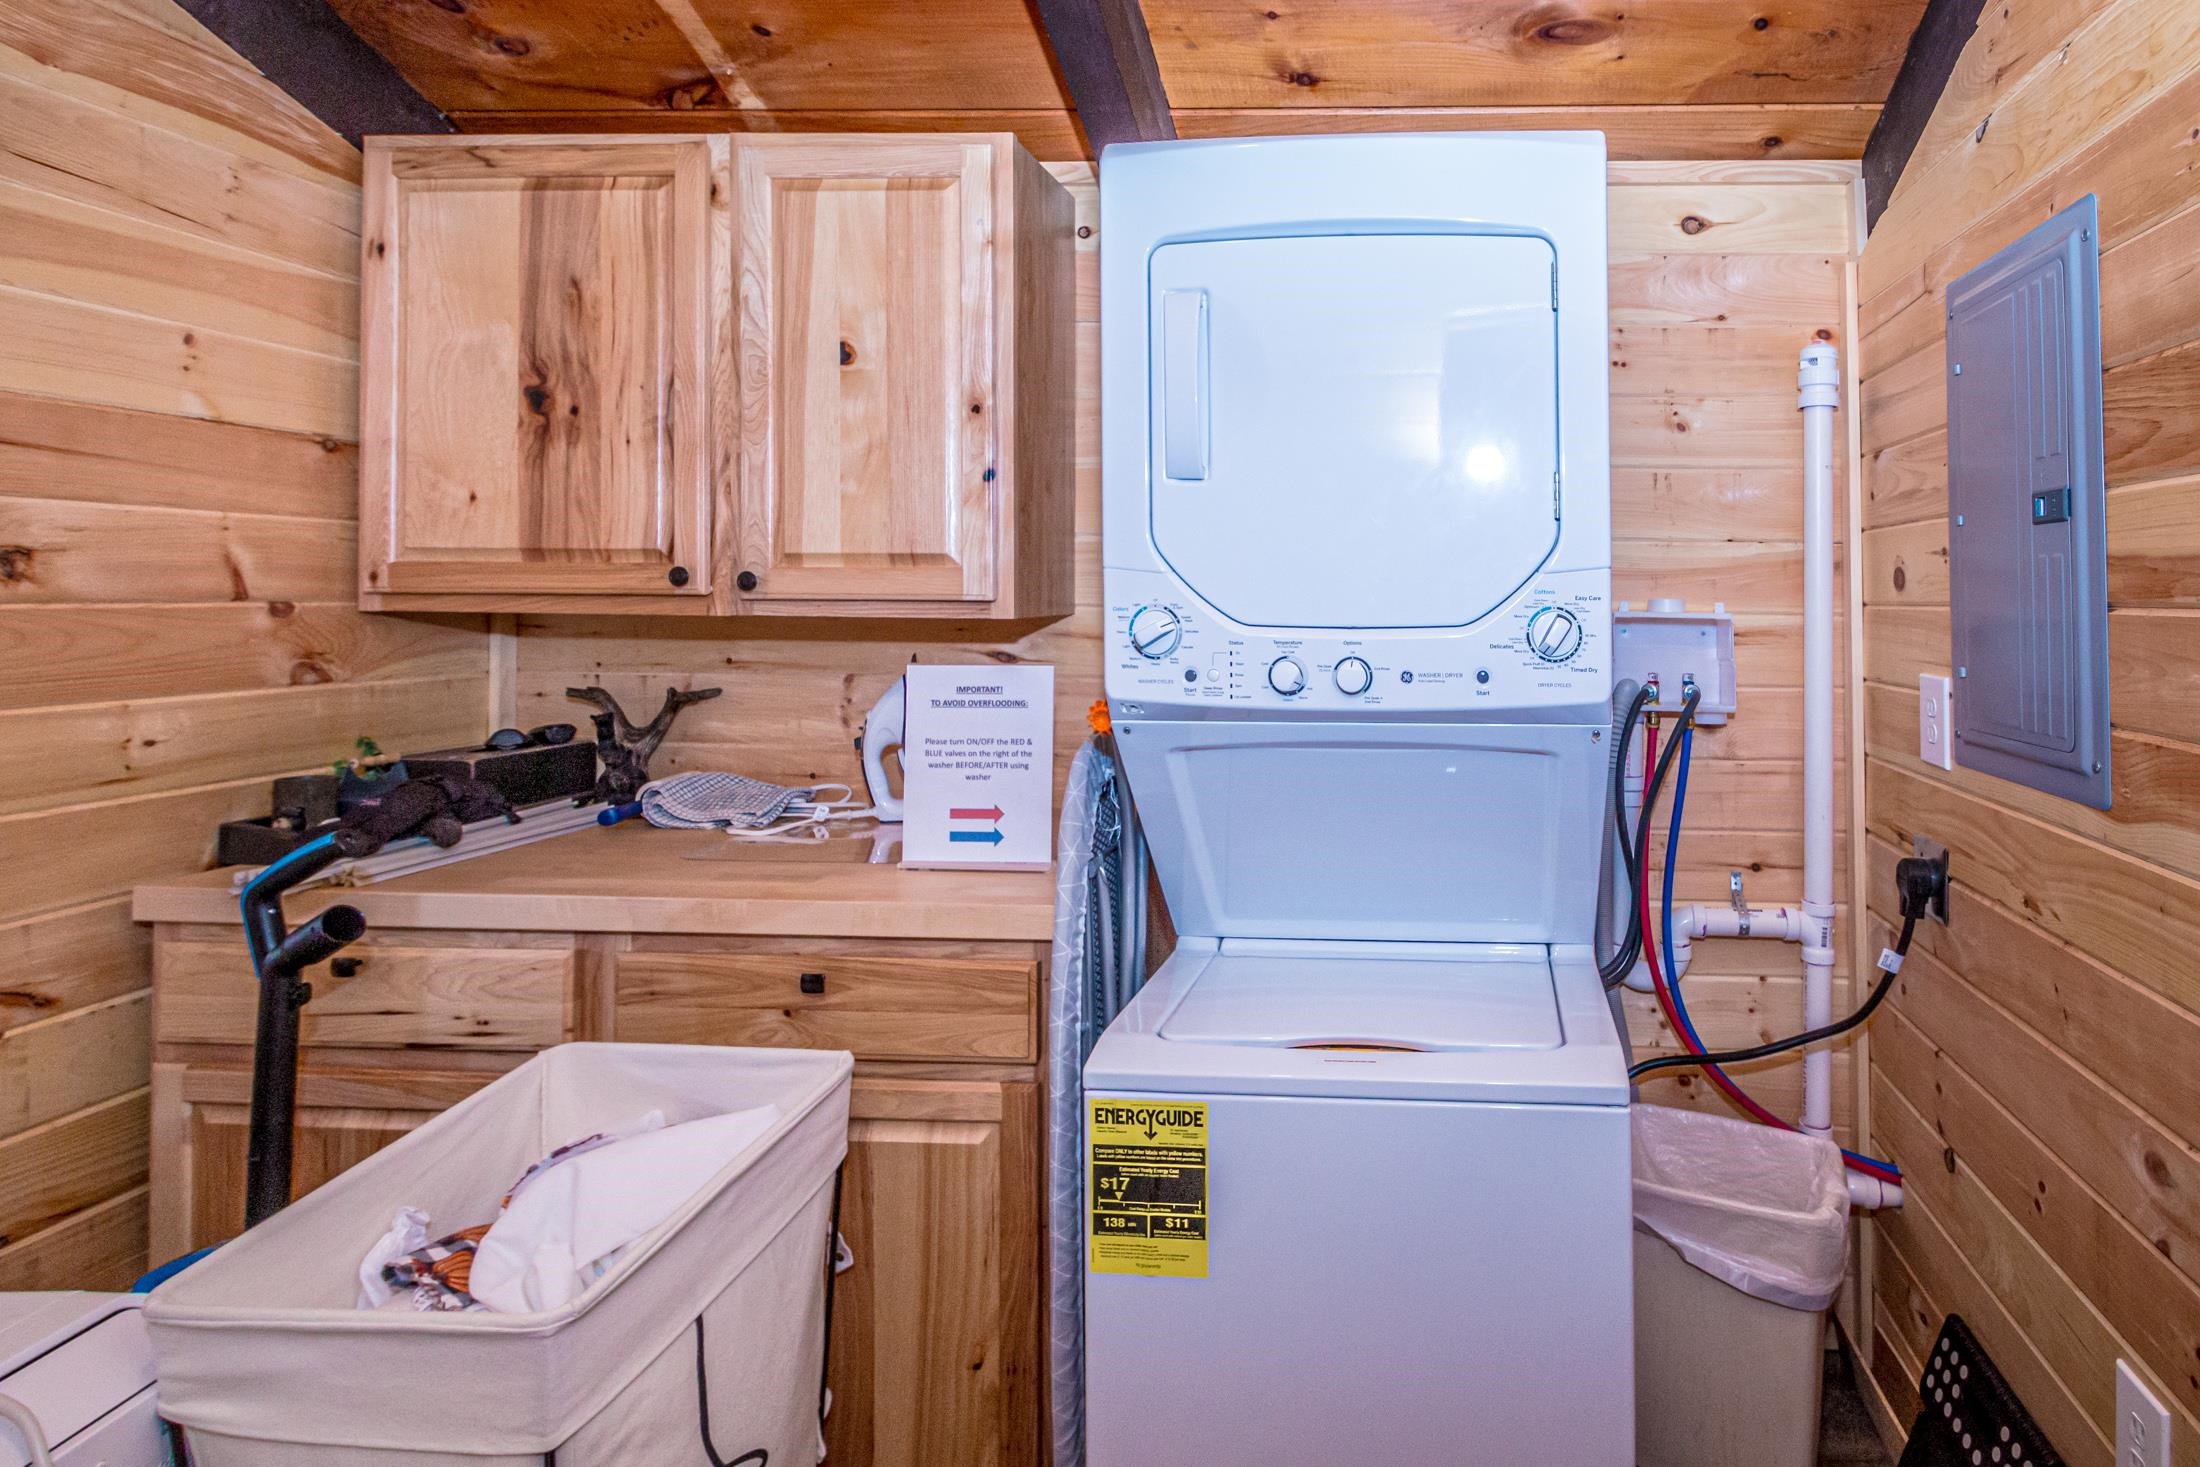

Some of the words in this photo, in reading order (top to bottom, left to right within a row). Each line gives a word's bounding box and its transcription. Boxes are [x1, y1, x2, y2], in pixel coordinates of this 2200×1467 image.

[956, 685, 1003, 694] IMPORTANT!
[931, 699, 941, 708] TO
[943, 699, 966, 708] AVOID
[967, 699, 1029, 708] OVERFLOODING:
[924, 738, 948, 746] Please
[966, 738, 995, 747] ON/OFF
[996, 738, 1009, 746] the
[1010, 738, 1026, 746] RED
[1026, 738, 1033, 746] &
[924, 750, 943, 758] BLUE
[944, 750, 966, 758] valves
[979, 750, 992, 758] the
[992, 750, 1010, 759] right
[1011, 750, 1019, 758] of
[1020, 750, 1033, 758] the
[928, 761, 954, 769] washer
[955, 761, 1008, 769] BEFORE/AFTER
[1009, 762, 1030, 771] using
[1094, 1107, 1204, 1128] ENERGYGUIDE
[1100, 1177, 1130, 1190] $17
[1102, 1217, 1126, 1228] 138
[1165, 1217, 1189, 1229] $11
